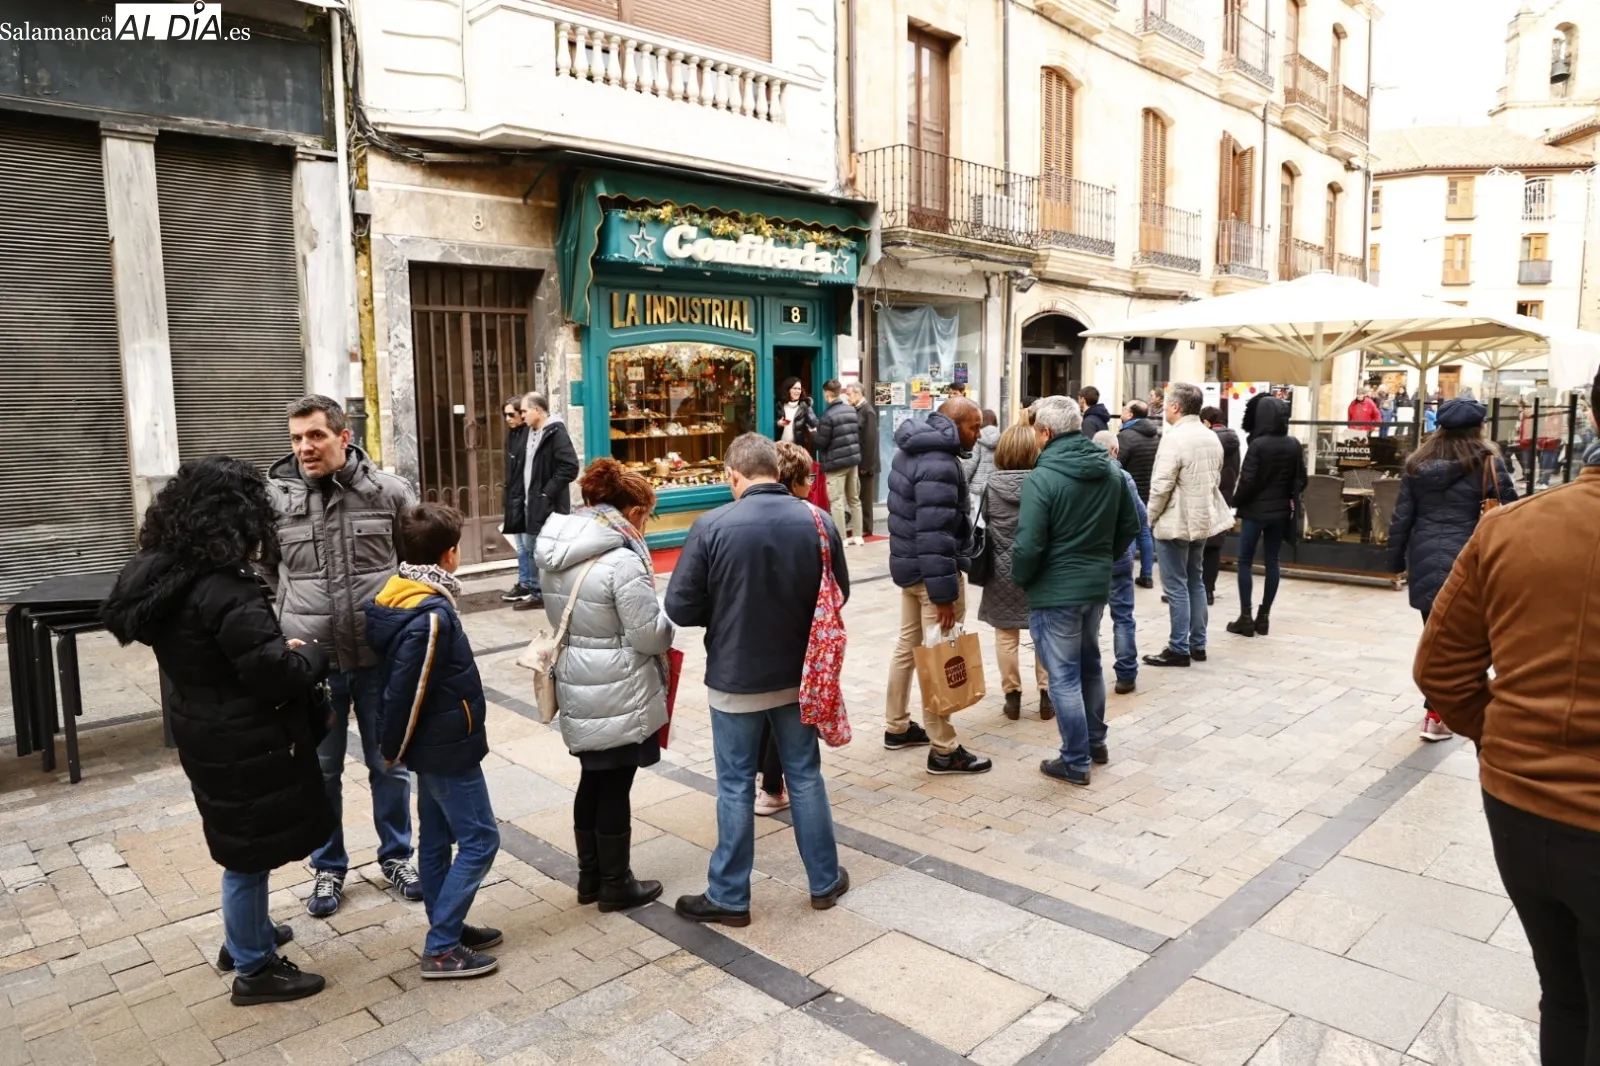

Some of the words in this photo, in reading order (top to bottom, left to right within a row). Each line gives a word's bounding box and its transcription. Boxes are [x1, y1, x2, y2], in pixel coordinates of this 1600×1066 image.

[472, 213, 484, 231] 8
[611, 292, 640, 329] LA
[645, 294, 754, 334] INDUSTRIAL
[790, 306, 801, 324] 8
[946, 668, 968, 684] KING
